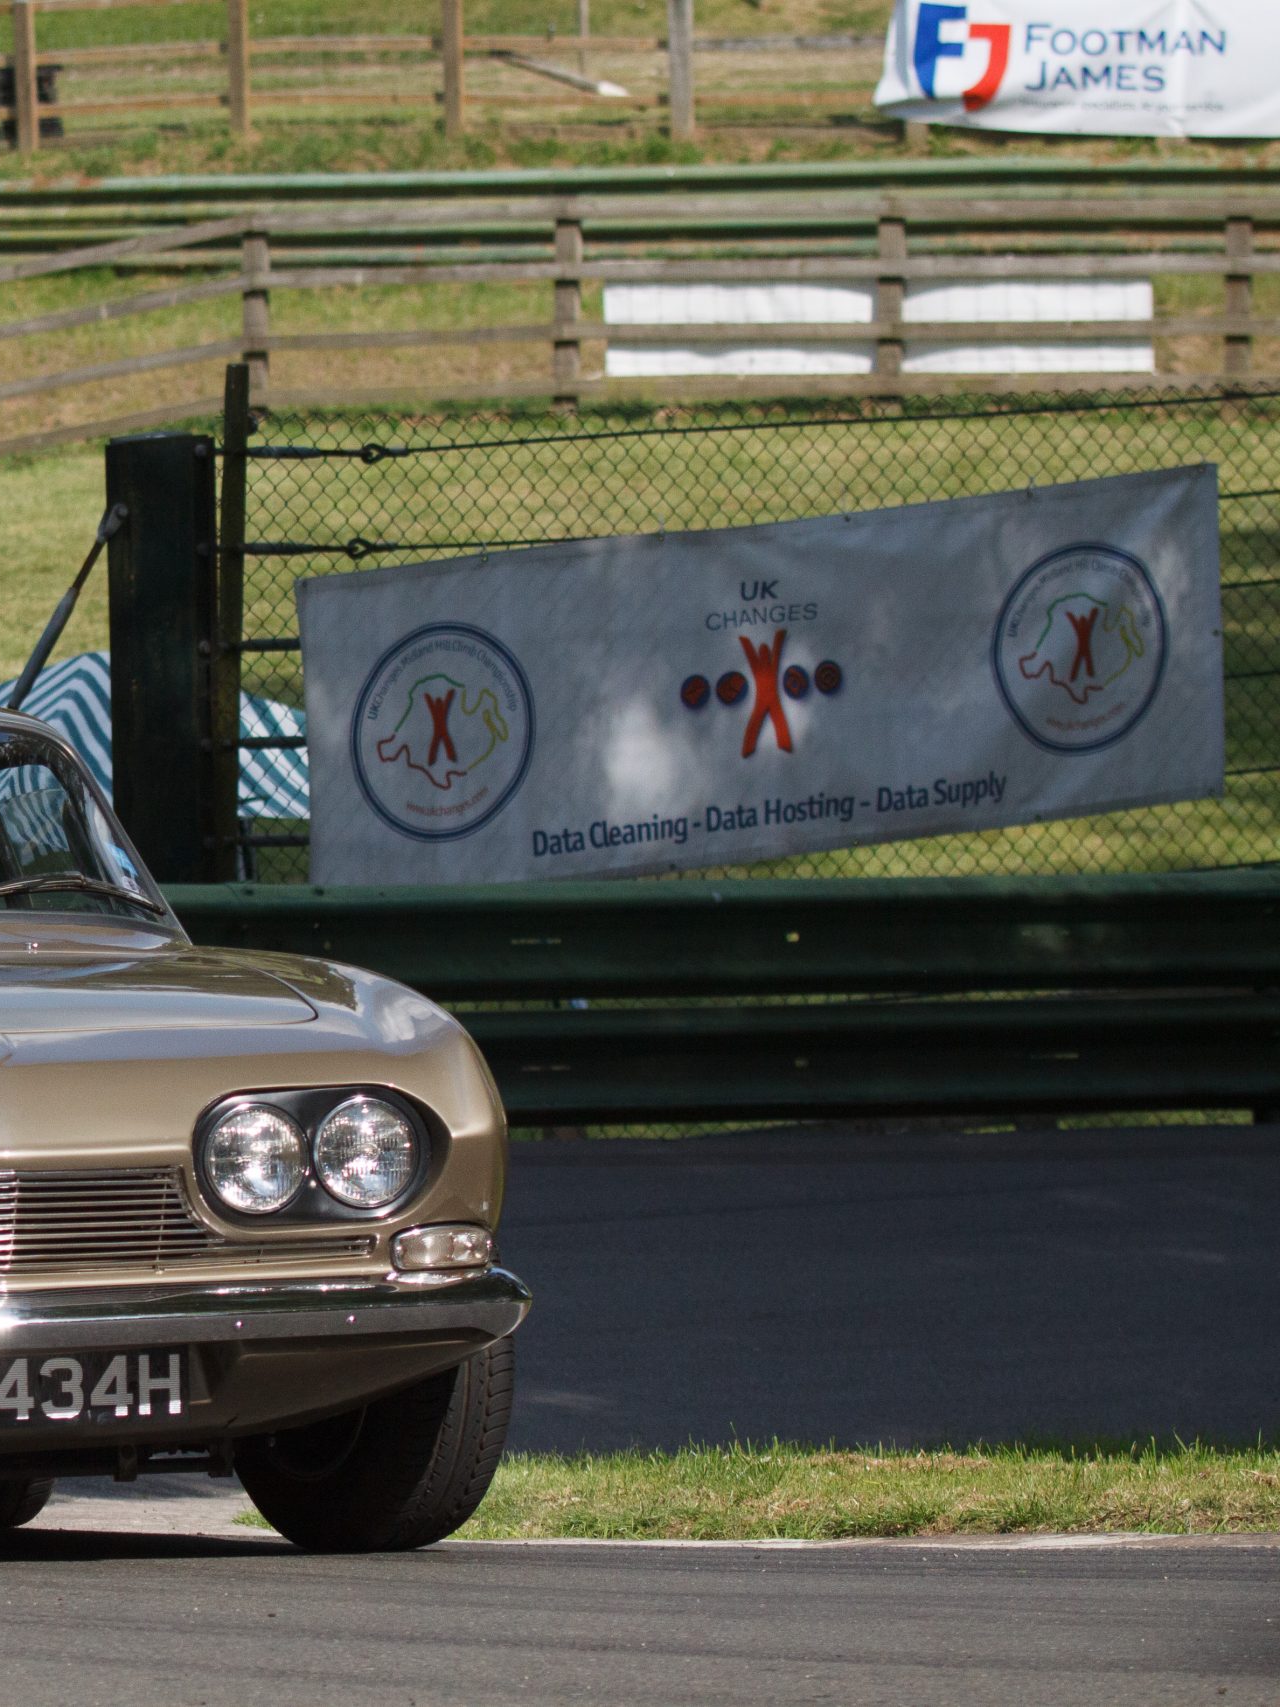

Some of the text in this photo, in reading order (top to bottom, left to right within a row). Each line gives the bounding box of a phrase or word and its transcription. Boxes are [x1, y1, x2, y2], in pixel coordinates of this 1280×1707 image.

[1024, 22, 1226, 55] FOOTMAN
[1024, 61, 1166, 92] JAMES
[740, 580, 779, 601] UK
[705, 603, 818, 631] CHANGES
[532, 829, 586, 857] Data
[589, 814, 689, 844] Cleaning
[706, 805, 759, 832] Data
[764, 792, 855, 822] Hosting
[877, 784, 929, 812] Data
[933, 770, 1007, 808] Supply
